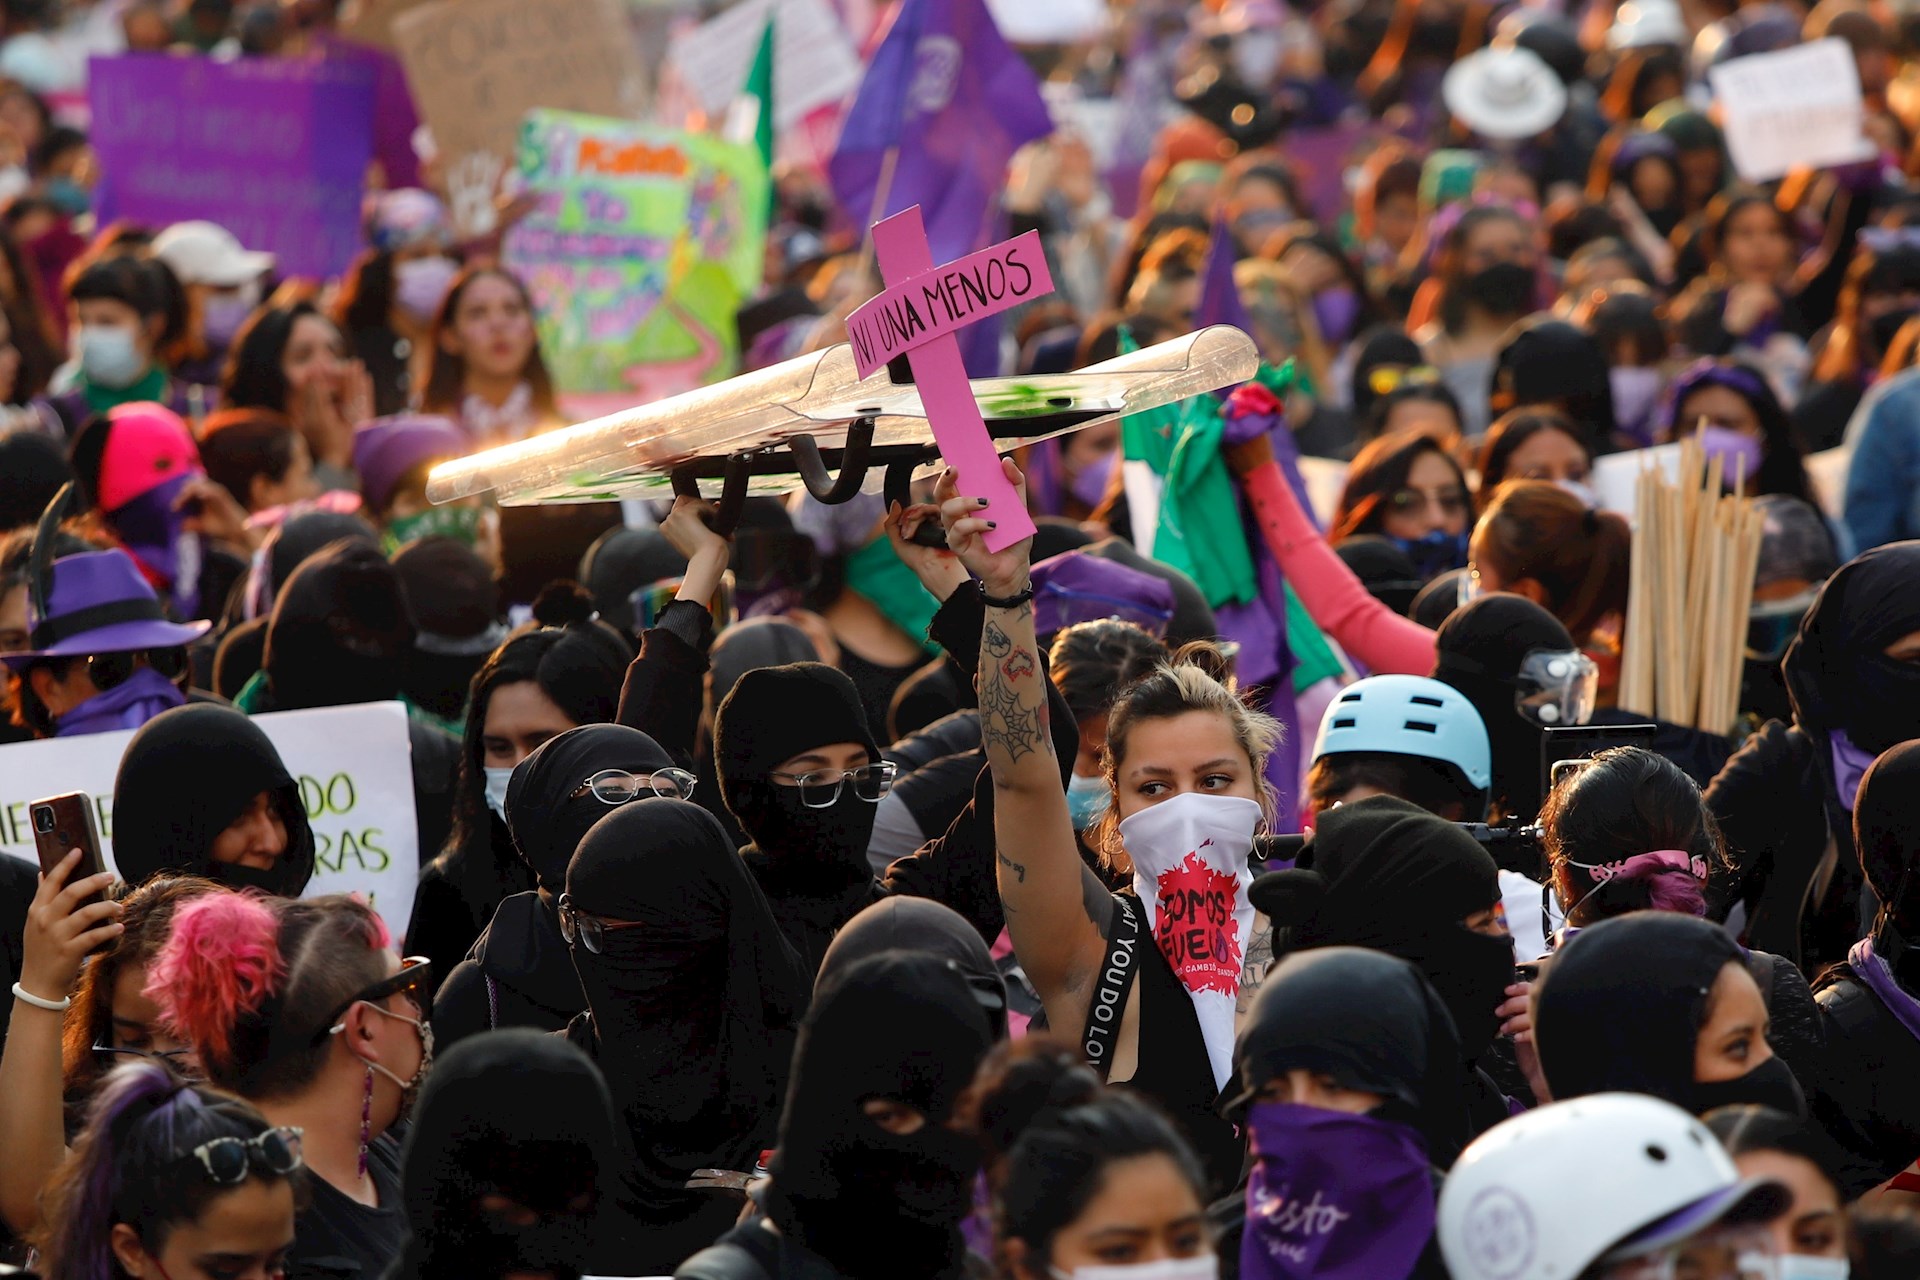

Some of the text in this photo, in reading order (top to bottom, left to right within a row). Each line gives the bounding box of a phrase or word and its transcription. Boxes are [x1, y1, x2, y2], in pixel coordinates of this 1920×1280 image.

[853, 248, 1032, 369] NI UNA MENOS
[1105, 938, 1136, 986] YOU
[1185, 962, 1217, 974] CAMBIÓ
[1094, 987, 1120, 1022] DO
